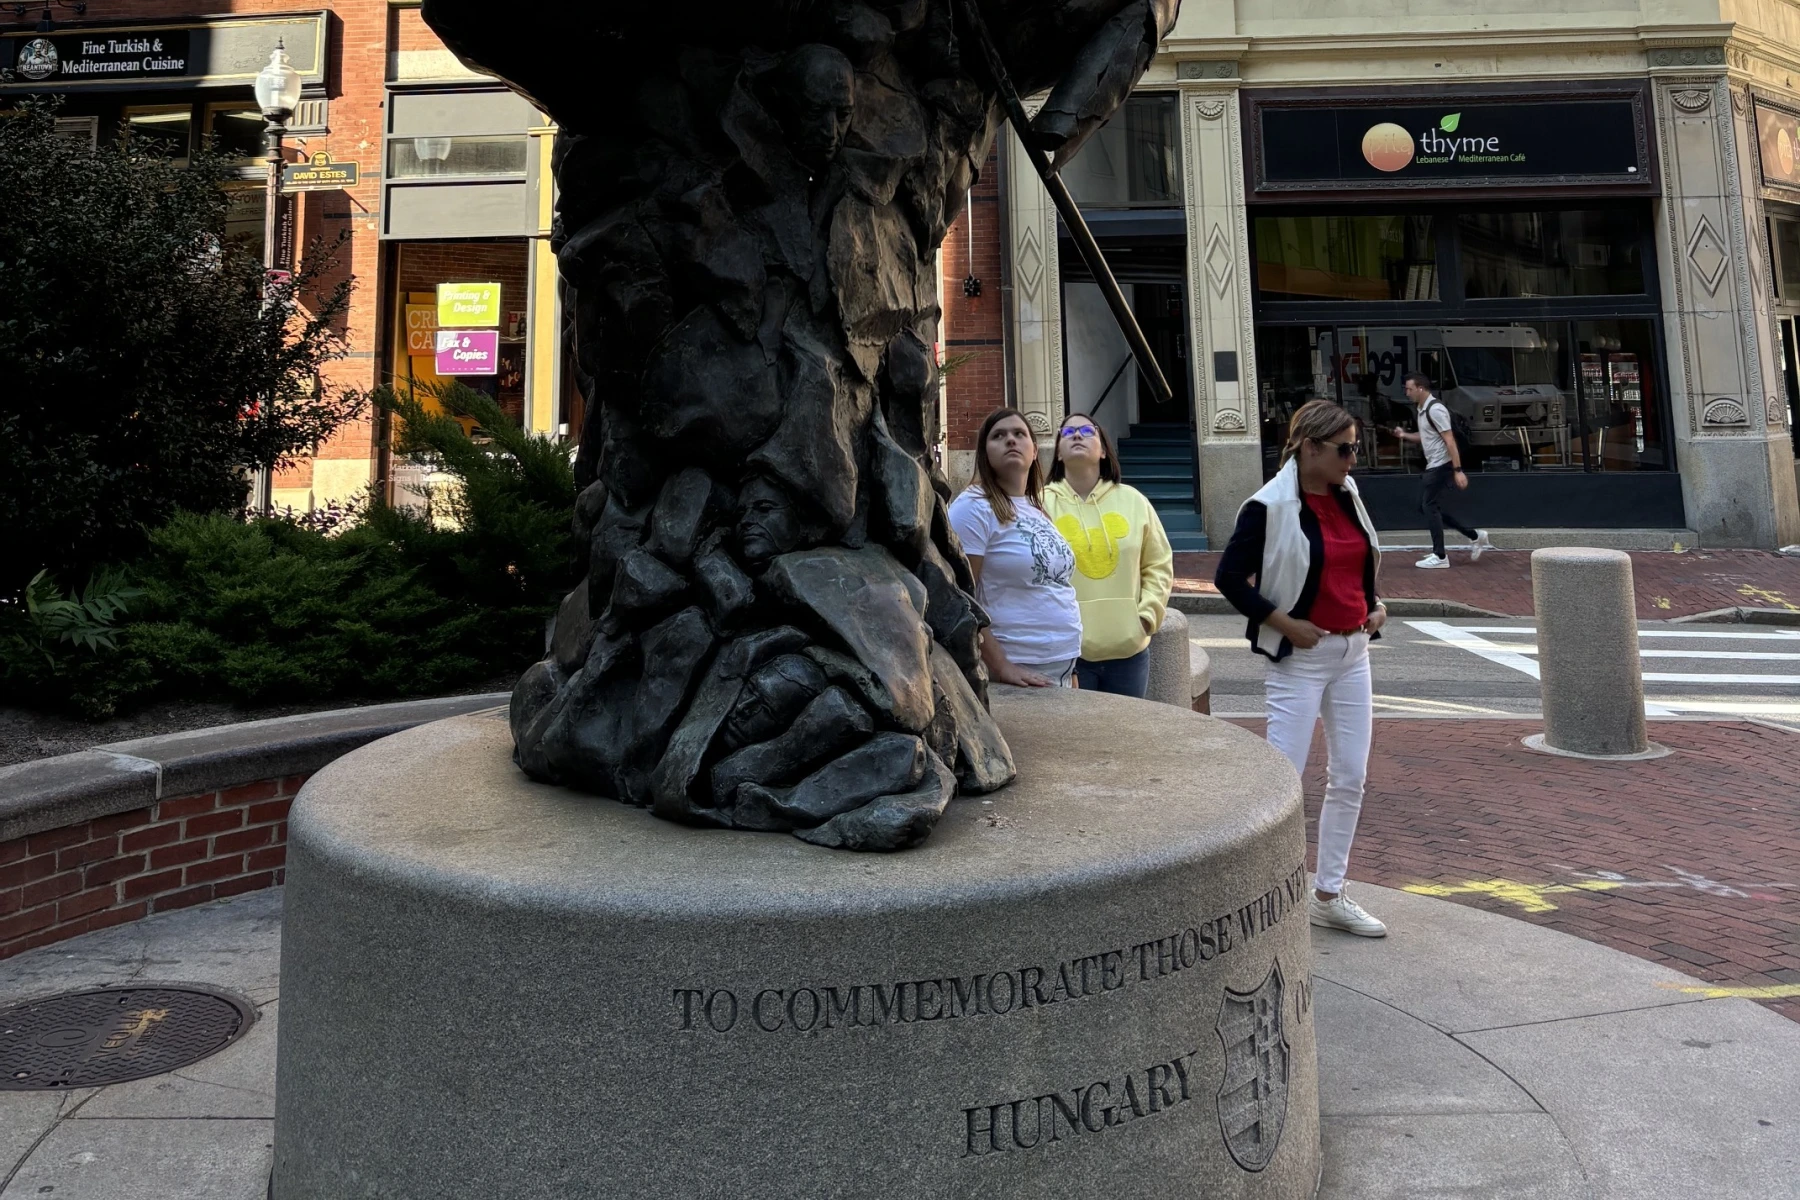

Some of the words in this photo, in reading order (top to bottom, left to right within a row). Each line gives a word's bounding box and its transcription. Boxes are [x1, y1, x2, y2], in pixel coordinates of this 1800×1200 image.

[82, 41, 105, 54] Fine
[108, 39, 150, 53] Turkish
[152, 38, 163, 52] &
[61, 59, 140, 74] Mediterranean
[142, 56, 185, 71] Cuisine
[1369, 132, 1411, 162] pita
[1419, 128, 1500, 161] thyme
[1416, 155, 1449, 164] Lebanese
[1458, 154, 1509, 163] Mediterranean
[1509, 153, 1526, 162] Café
[293, 172, 317, 180] DAVID
[319, 170, 347, 179] ESTES
[443, 290, 480, 303] Printing
[482, 289, 491, 300] &
[453, 302, 488, 314] Design
[441, 337, 460, 348] Fax
[461, 336, 471, 348] &
[452, 348, 489, 362] Copies
[673, 988, 738, 1033] TO
[752, 950, 1124, 1033] COMMEMORATE
[1131, 913, 1233, 981] THOSE
[1237, 886, 1283, 943] WHO
[960, 1050, 1198, 1158] HUNGARY
